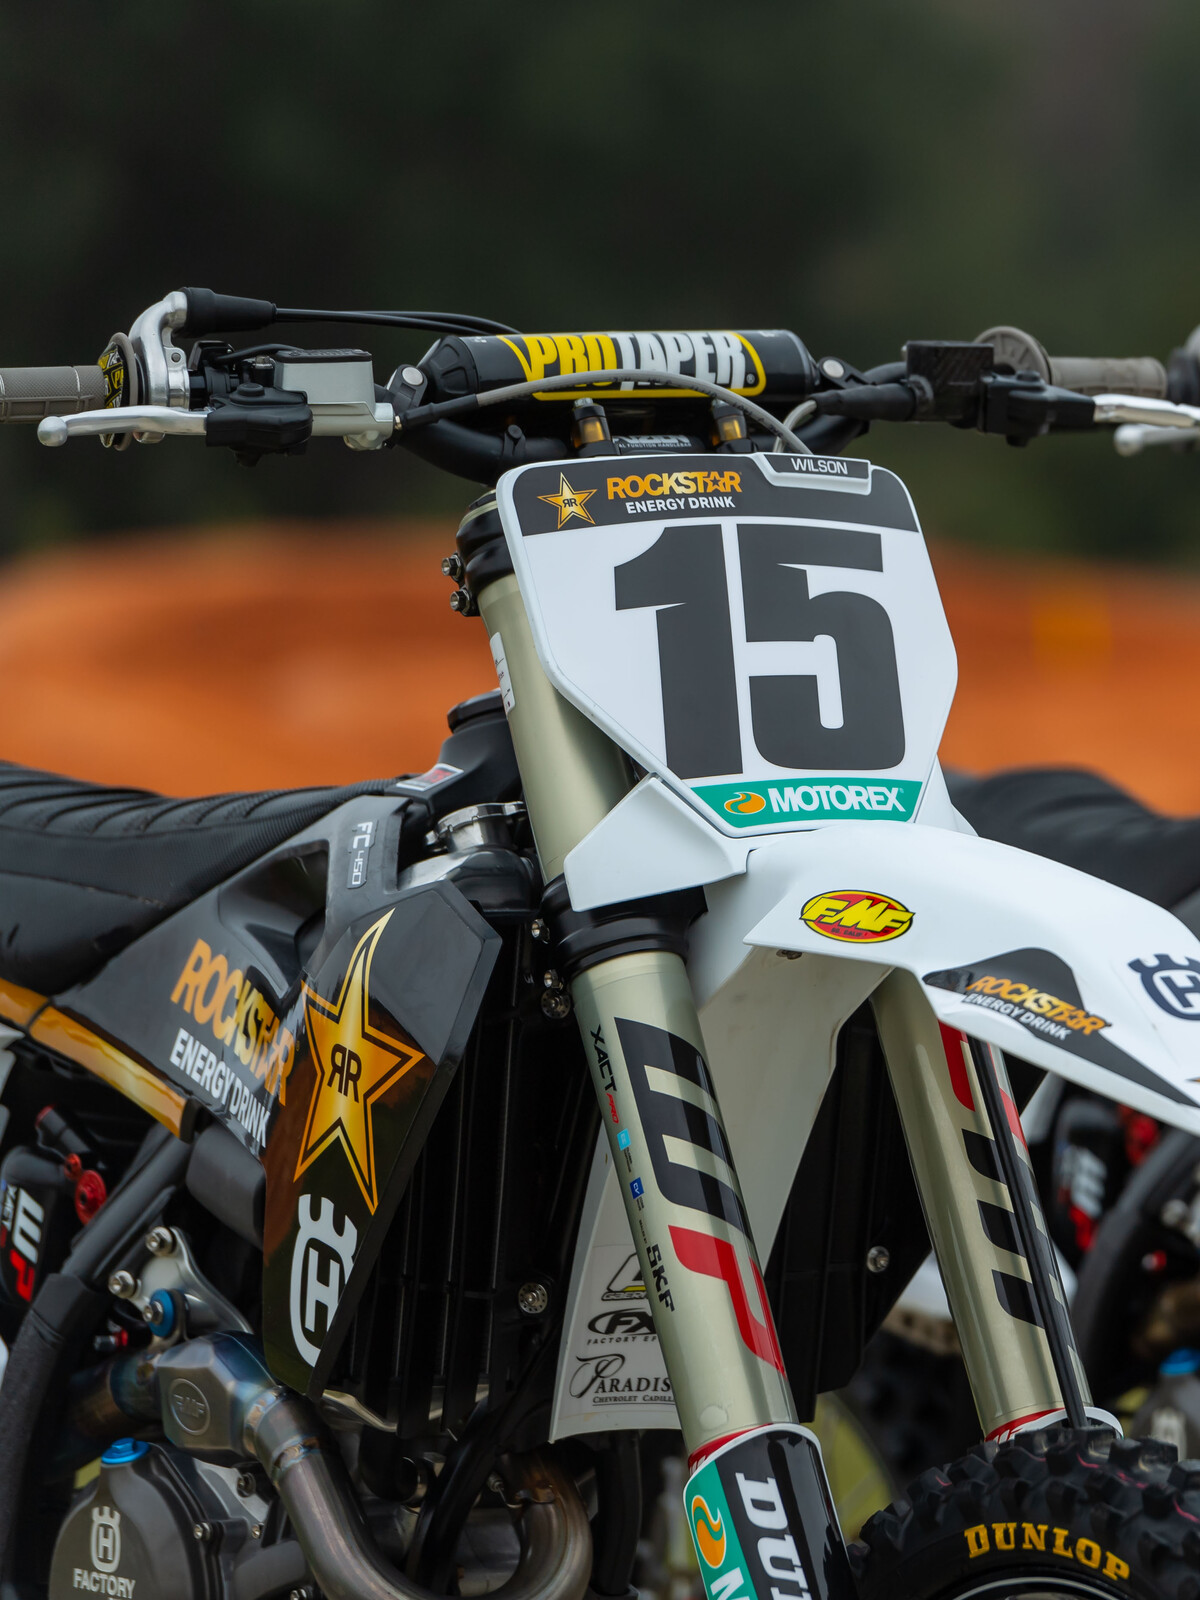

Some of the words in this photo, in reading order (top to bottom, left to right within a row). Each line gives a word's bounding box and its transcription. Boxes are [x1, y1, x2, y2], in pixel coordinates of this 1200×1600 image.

[791, 458, 848, 475] WILSON
[606, 471, 742, 500] ROCKSTAR
[625, 497, 685, 514] ENERGY
[688, 496, 735, 509] DRINK
[614, 523, 905, 780] 15
[768, 784, 906, 813] MOTOREX
[353, 821, 373, 849] FC
[351, 850, 365, 885] 450
[799, 896, 916, 933] FMF
[170, 938, 295, 1106] ROCKSTAR
[966, 976, 1107, 1036] ROCKSTAR
[966, 993, 1024, 1018] ENERGY
[1019, 1011, 1072, 1040] DRINK
[589, 1024, 618, 1092] XACT
[169, 1027, 236, 1105] ENERGY
[229, 1077, 271, 1148] DRINK
[646, 1243, 675, 1312] SKF
[586, 1336, 638, 1345] FACTORY
[964, 1522, 1130, 1581] DUNLOP
[73, 1568, 136, 1599] FACTORY
